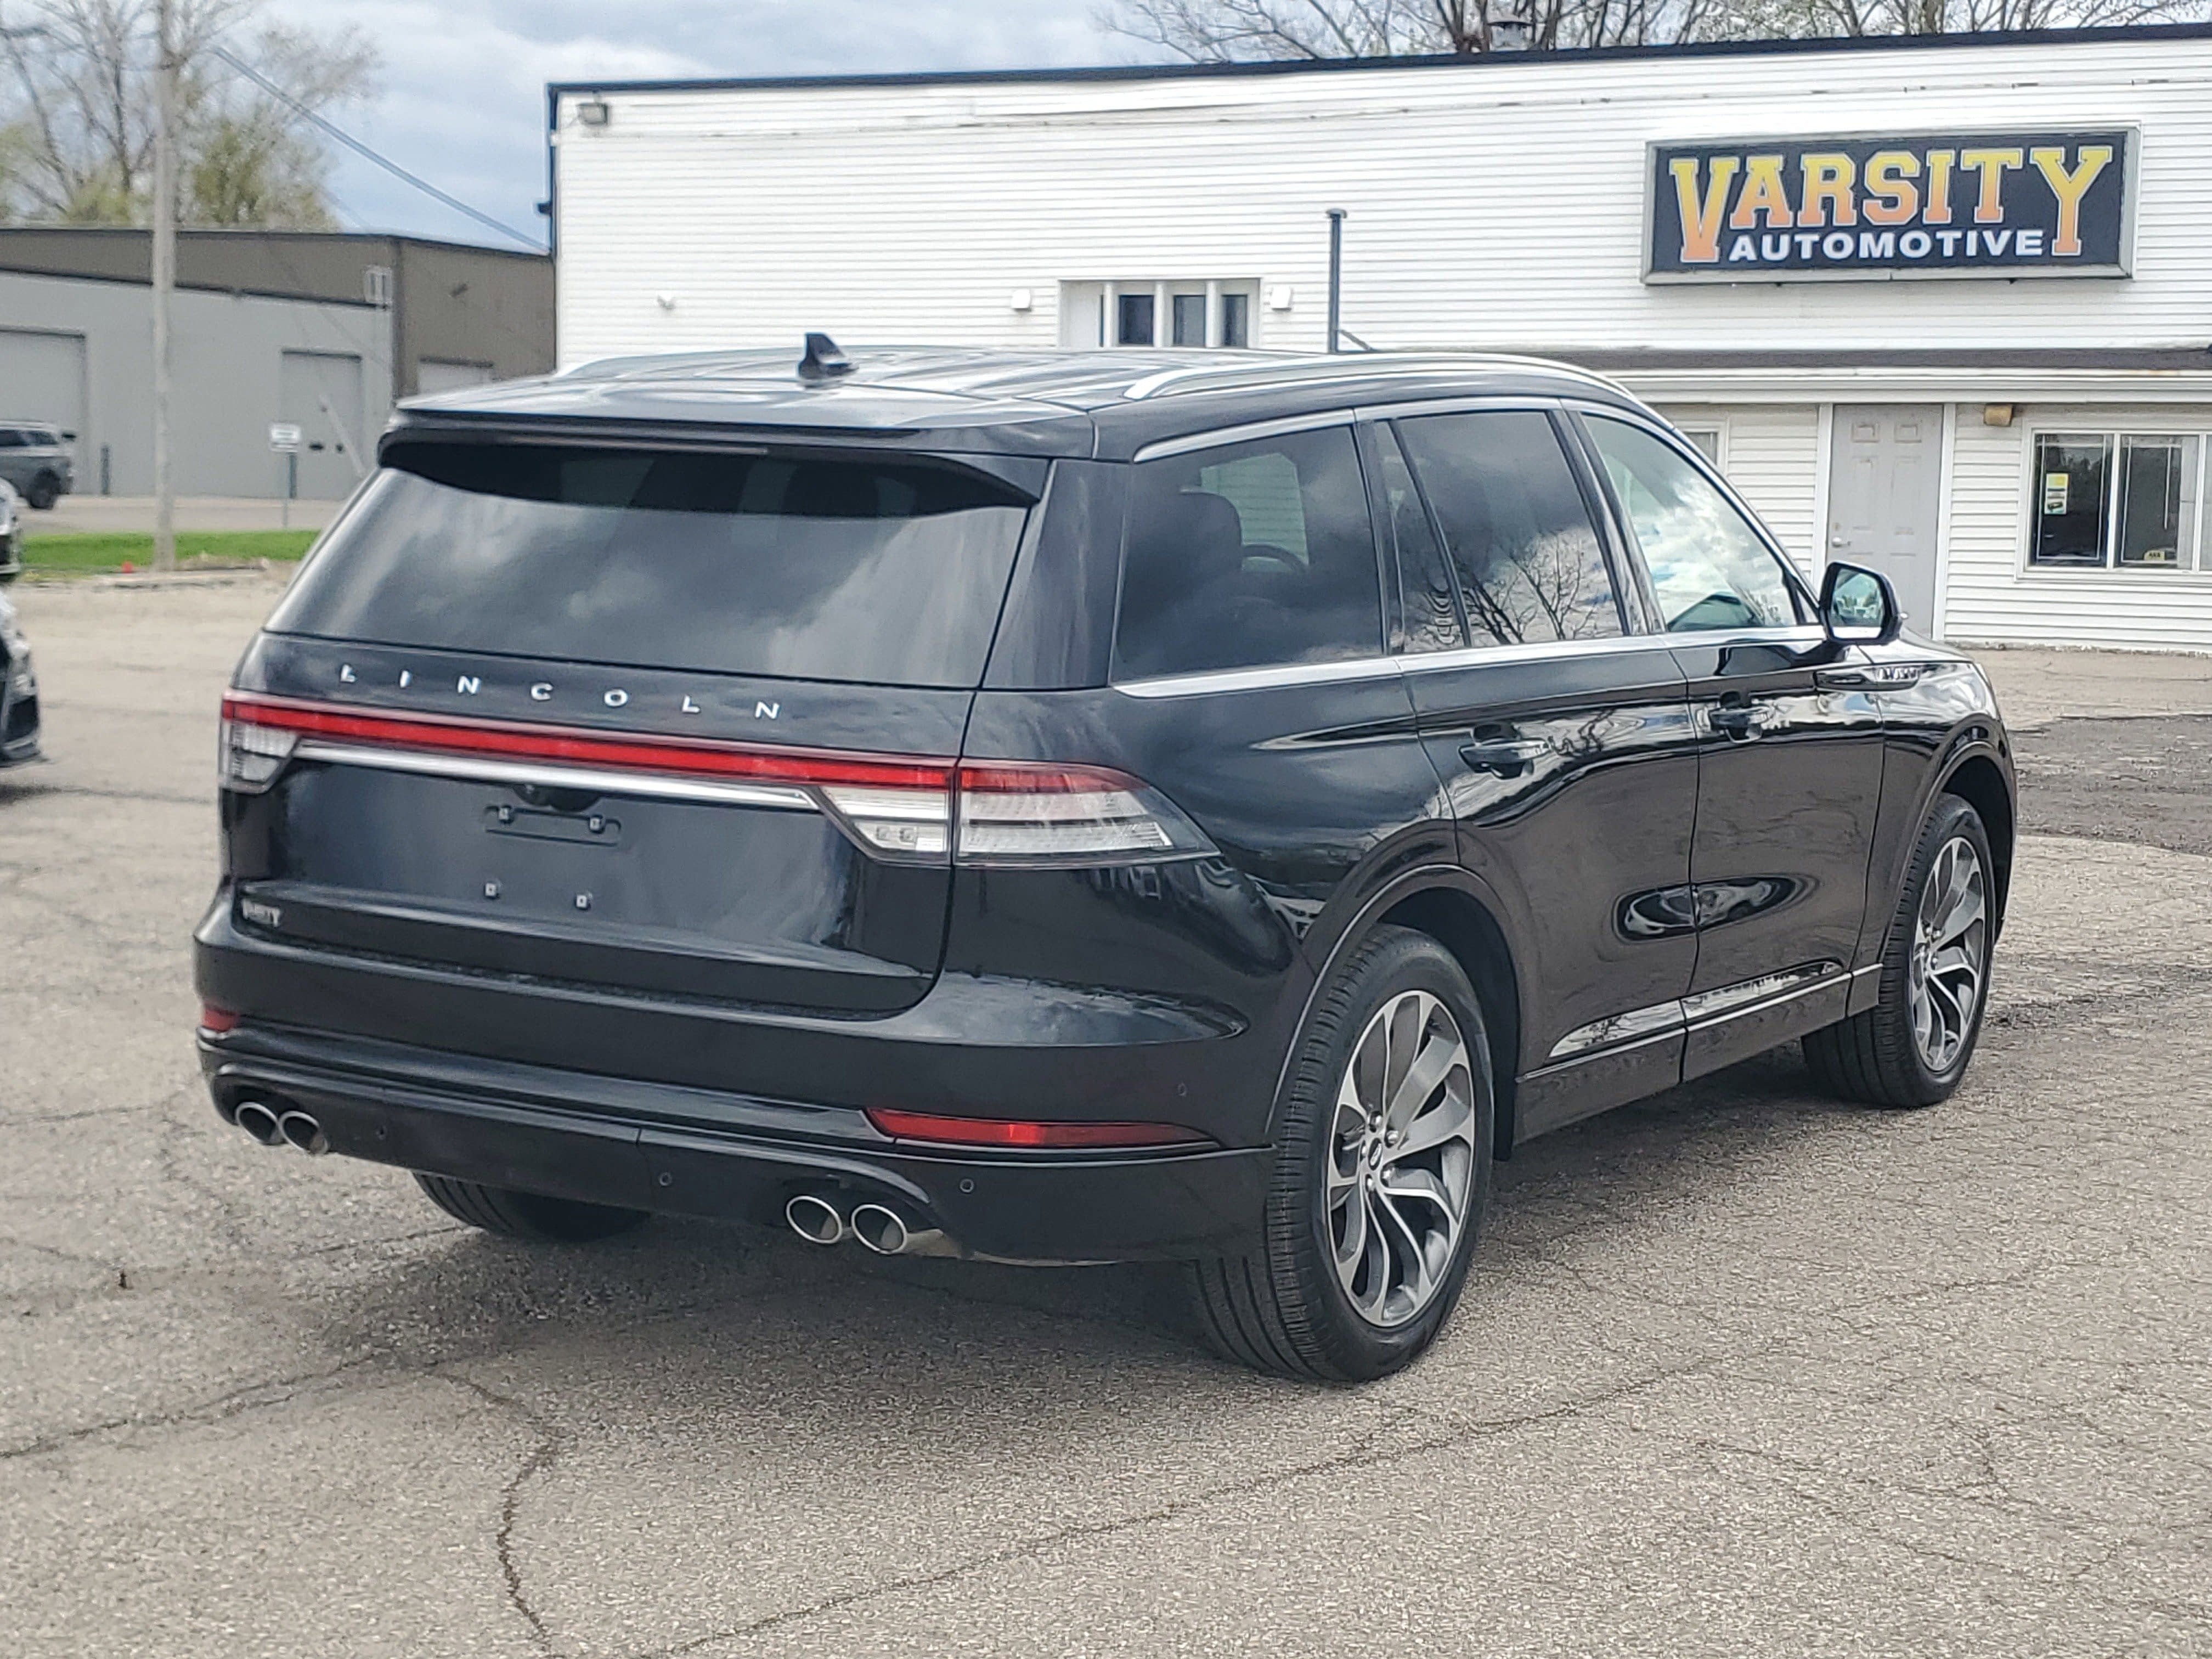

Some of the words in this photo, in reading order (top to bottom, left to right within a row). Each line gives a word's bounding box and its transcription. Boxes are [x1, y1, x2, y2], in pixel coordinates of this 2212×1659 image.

[1668, 146, 2112, 263] VARSITY
[1729, 229, 2044, 261] AUTOMOTIVE
[340, 664, 781, 719] LINCOLN
